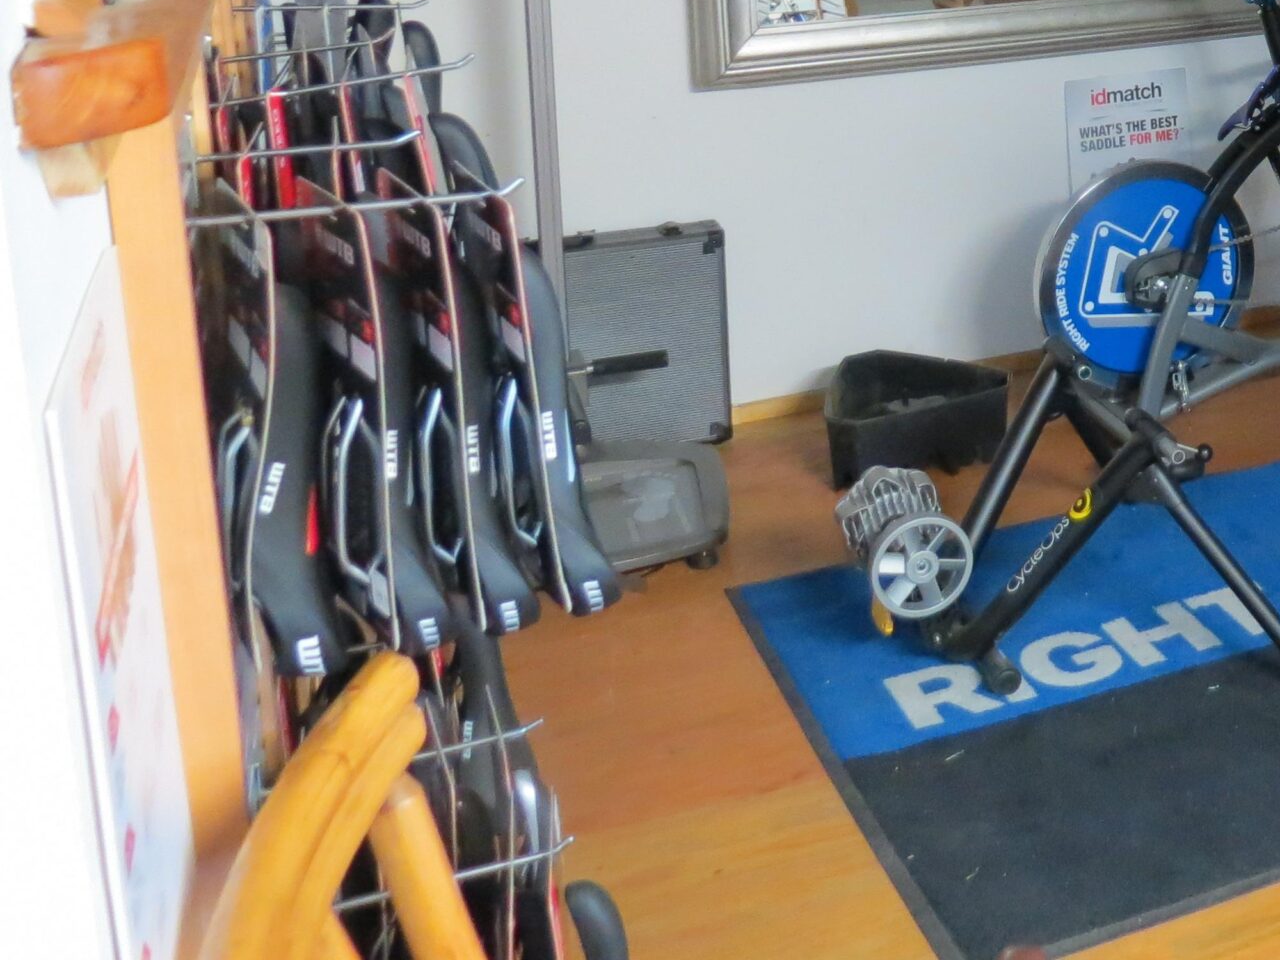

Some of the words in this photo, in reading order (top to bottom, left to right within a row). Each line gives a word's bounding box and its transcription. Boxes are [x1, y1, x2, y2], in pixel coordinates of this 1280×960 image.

[1090, 82, 1162, 106] idmatch
[1079, 123, 1123, 139] WHAT'S
[1126, 119, 1147, 133] THE
[1150, 115, 1178, 130] BEST
[1080, 135, 1126, 153] SADDLE
[1129, 132, 1152, 146] FOR
[1155, 128, 1180, 142] ME?
[1055, 232, 1080, 284] SYSTEM
[1219, 224, 1233, 285] GIANT
[1056, 285, 1070, 318] RIDE
[1062, 318, 1090, 352] RIGHT
[386, 428, 398, 479] WTB
[466, 424, 480, 473] WTB
[541, 411, 557, 461] WTB
[258, 462, 285, 514] WTB
[1006, 516, 1070, 592] CycleOps
[882, 584, 1263, 730] RIGHT
